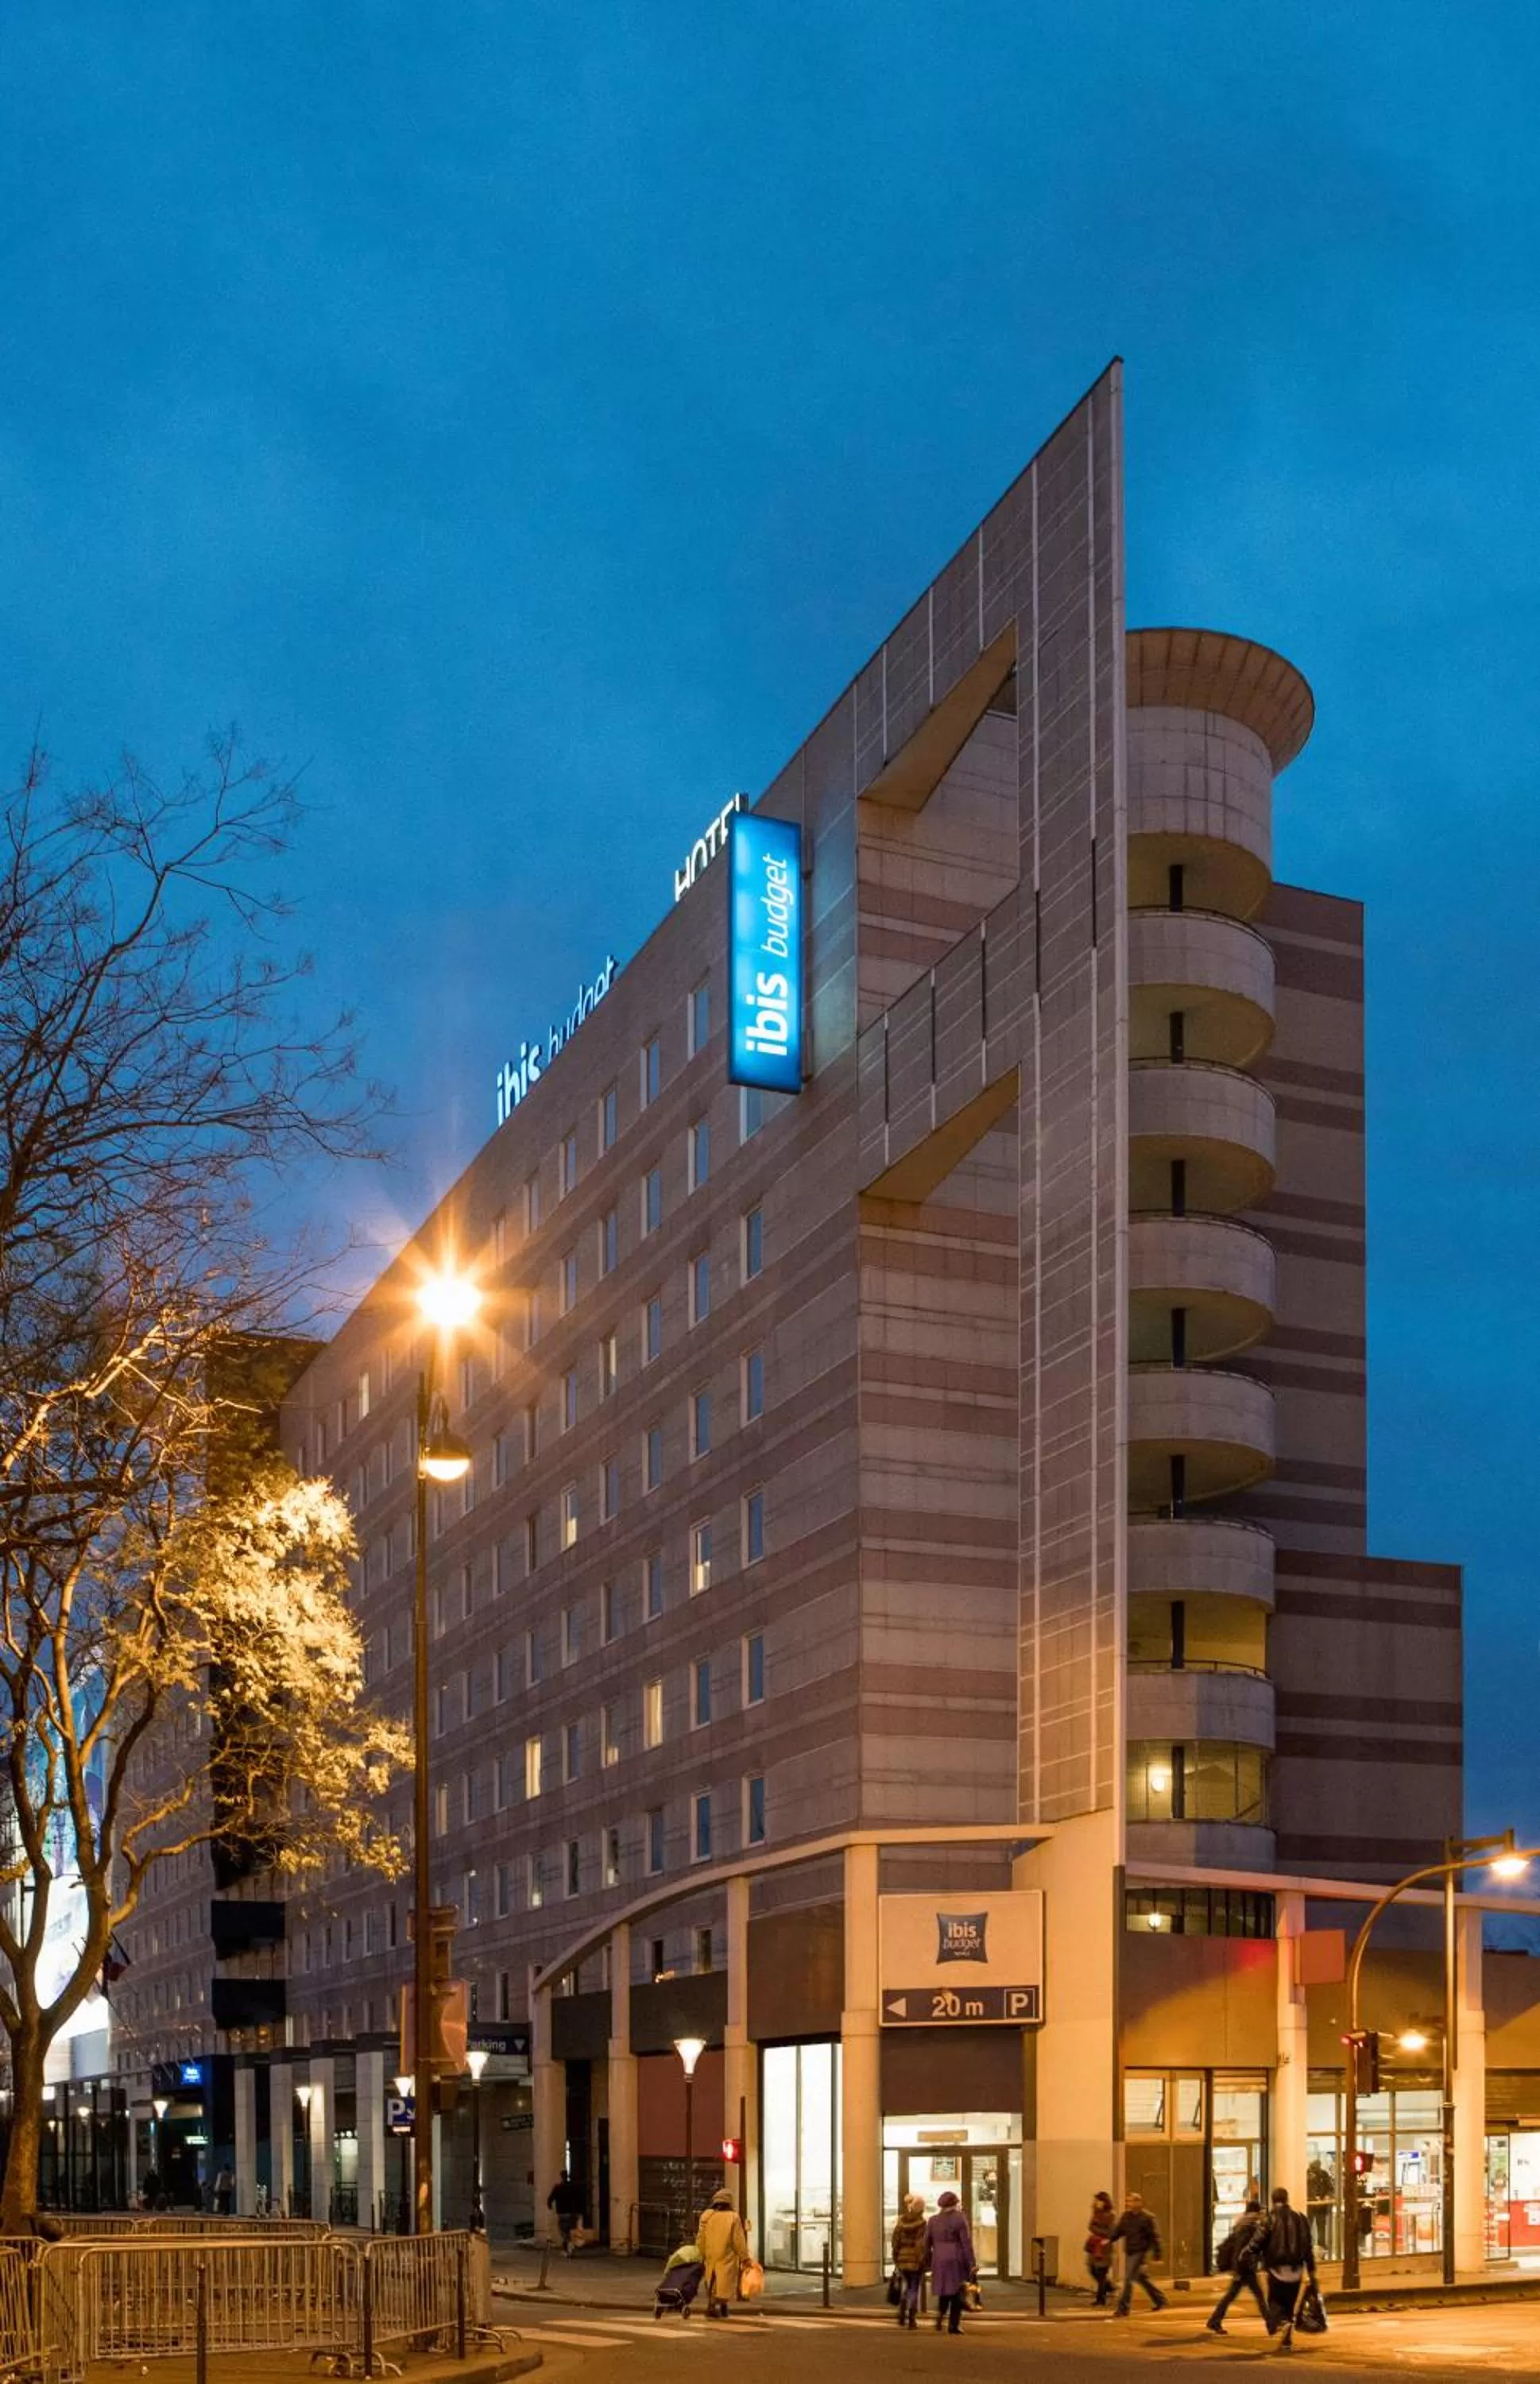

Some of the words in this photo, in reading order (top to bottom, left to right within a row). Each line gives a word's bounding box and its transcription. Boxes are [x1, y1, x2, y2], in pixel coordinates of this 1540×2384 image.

[675, 792, 741, 903] HOTE
[760, 852, 795, 958] budget
[745, 972, 789, 1056] ibis
[948, 1921, 977, 1938] ibis
[942, 1937, 981, 1952] budget
[931, 1995, 960, 2018] 20
[965, 2000, 983, 2016] m
[1011, 1993, 1028, 2016] P
[467, 2038, 507, 2053] arking
[387, 2098, 405, 2126] P
